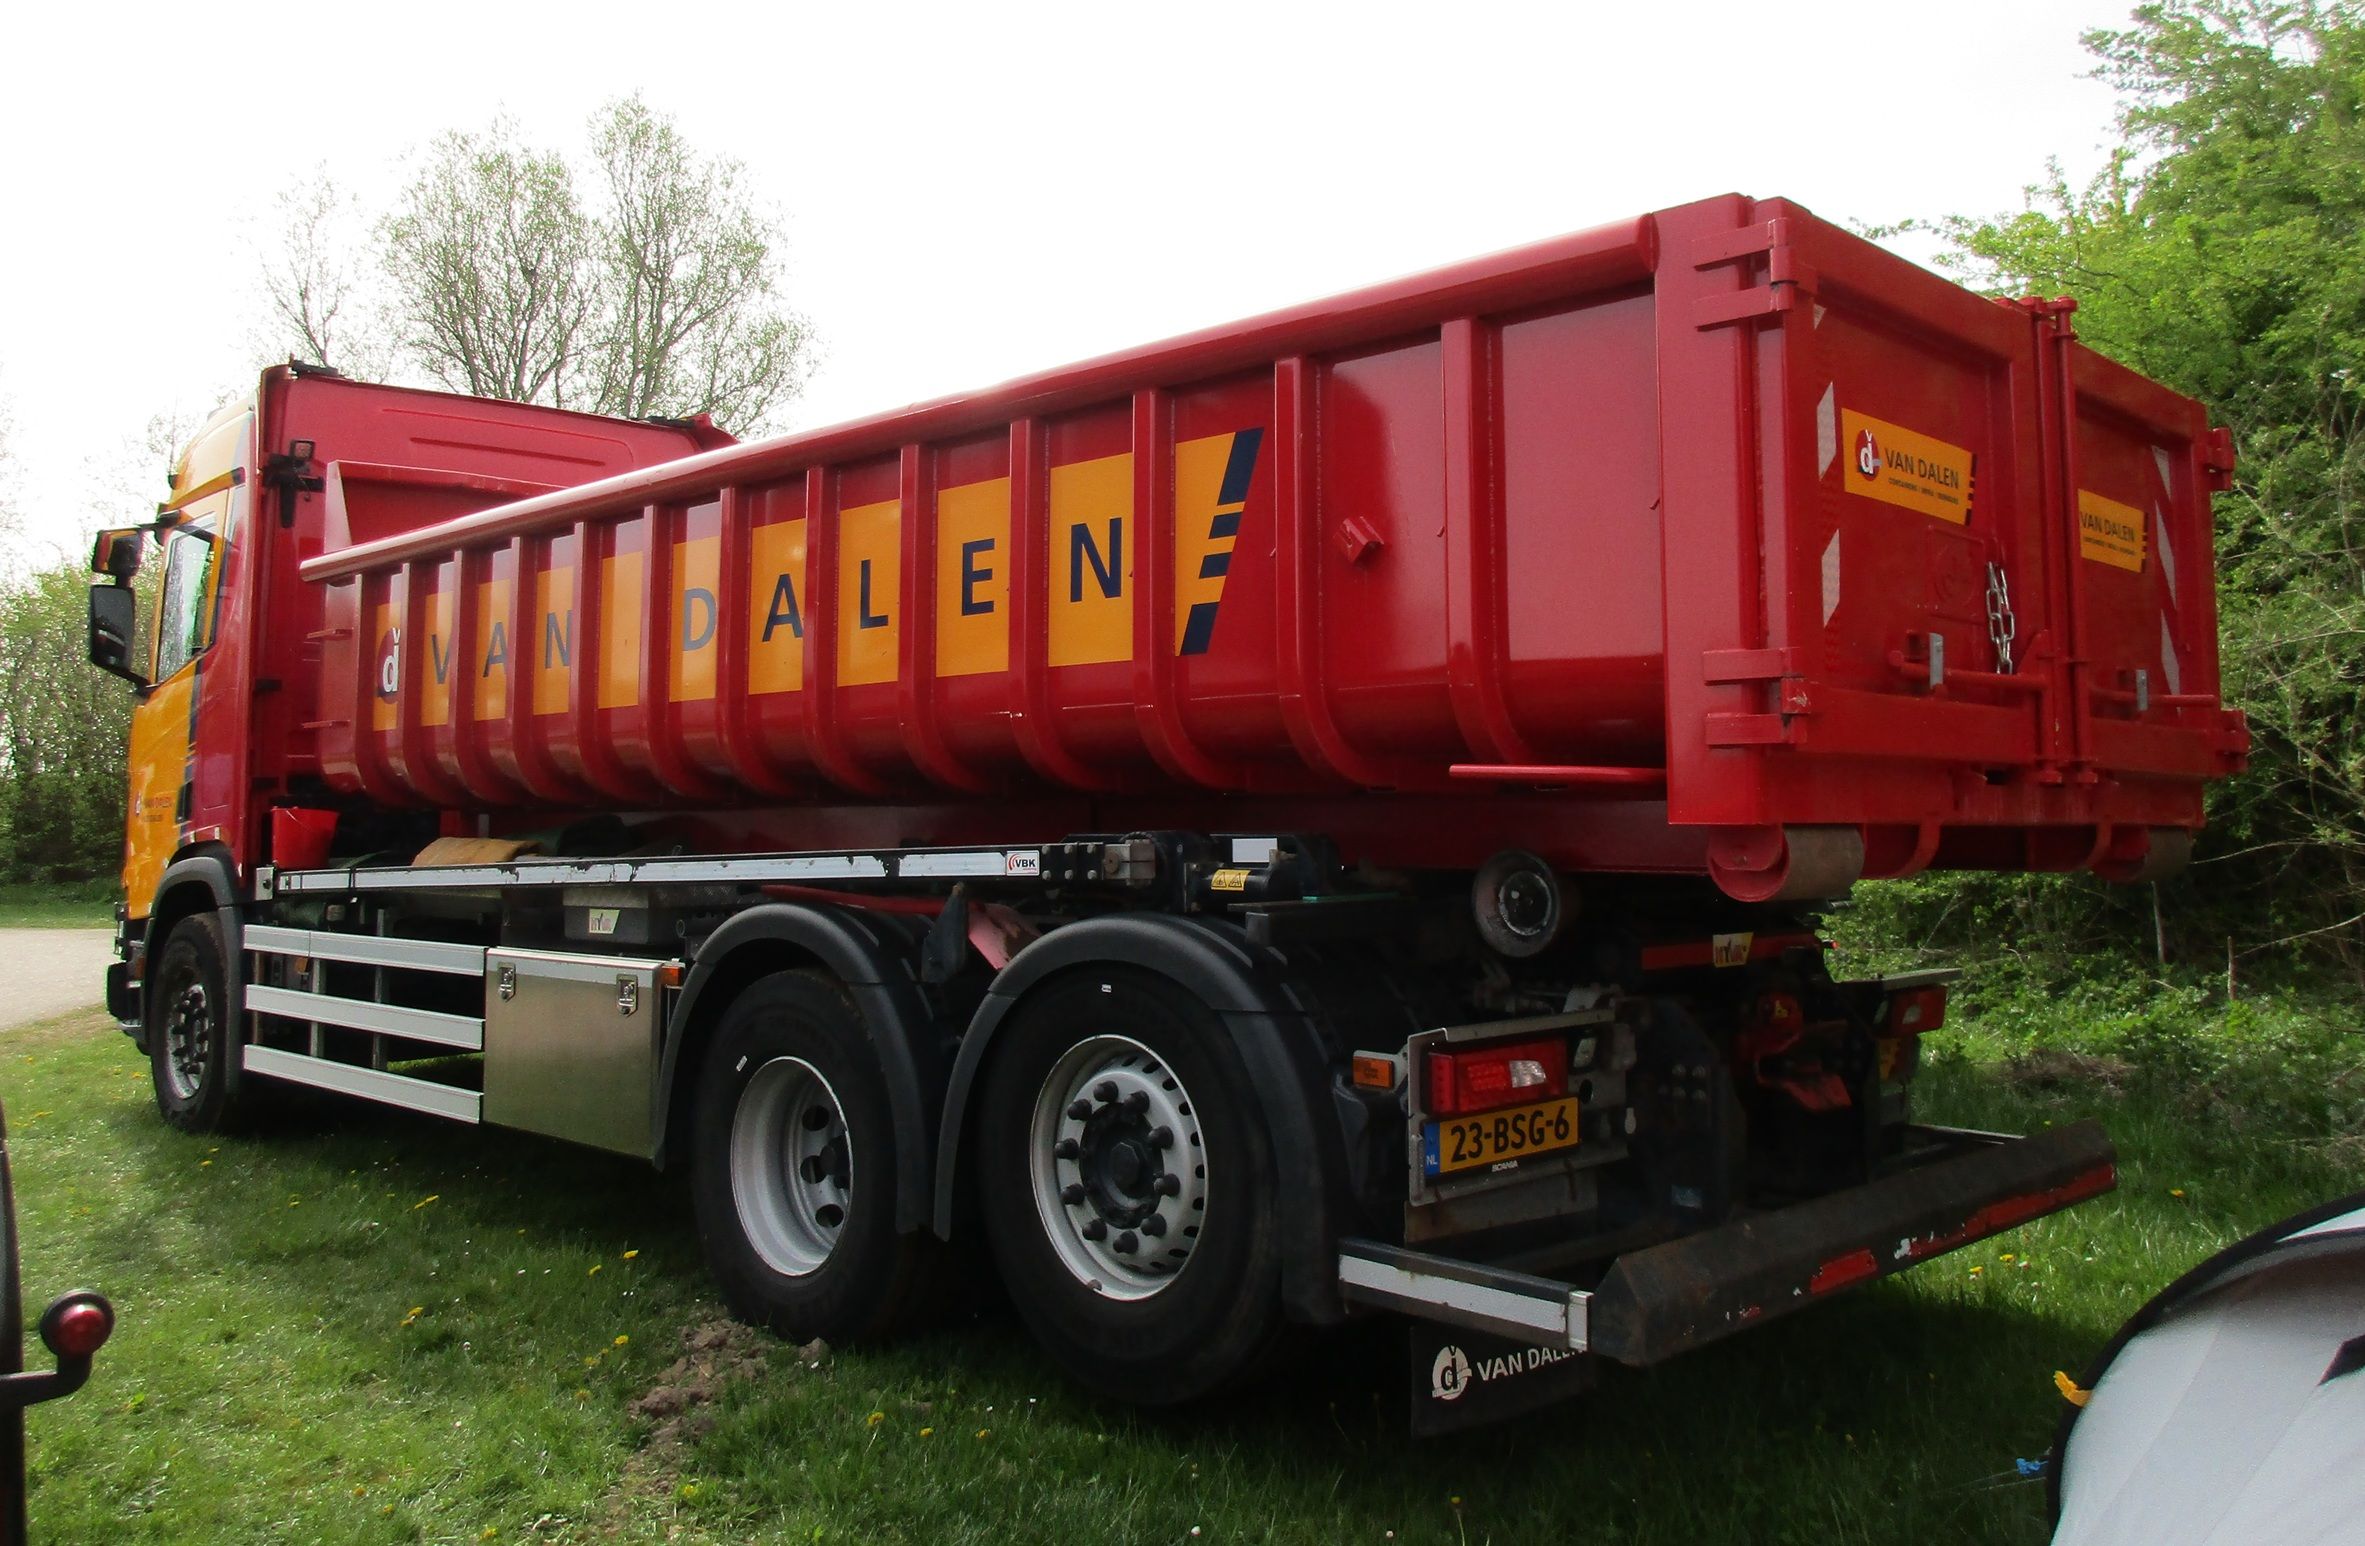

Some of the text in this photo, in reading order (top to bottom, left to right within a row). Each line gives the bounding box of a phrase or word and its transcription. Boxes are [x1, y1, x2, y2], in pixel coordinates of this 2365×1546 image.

[1885, 448, 1914, 475] VAN
[1918, 458, 1960, 489] DALEN
[2080, 511, 2135, 542] VAN DALEN
[431, 610, 573, 685] VAN
[682, 517, 1123, 651] DALEN
[1015, 859, 1036, 868] VBK
[1426, 1105, 1570, 1166] NL 23-BSG-6
[1477, 1352, 1523, 1381] VAN
